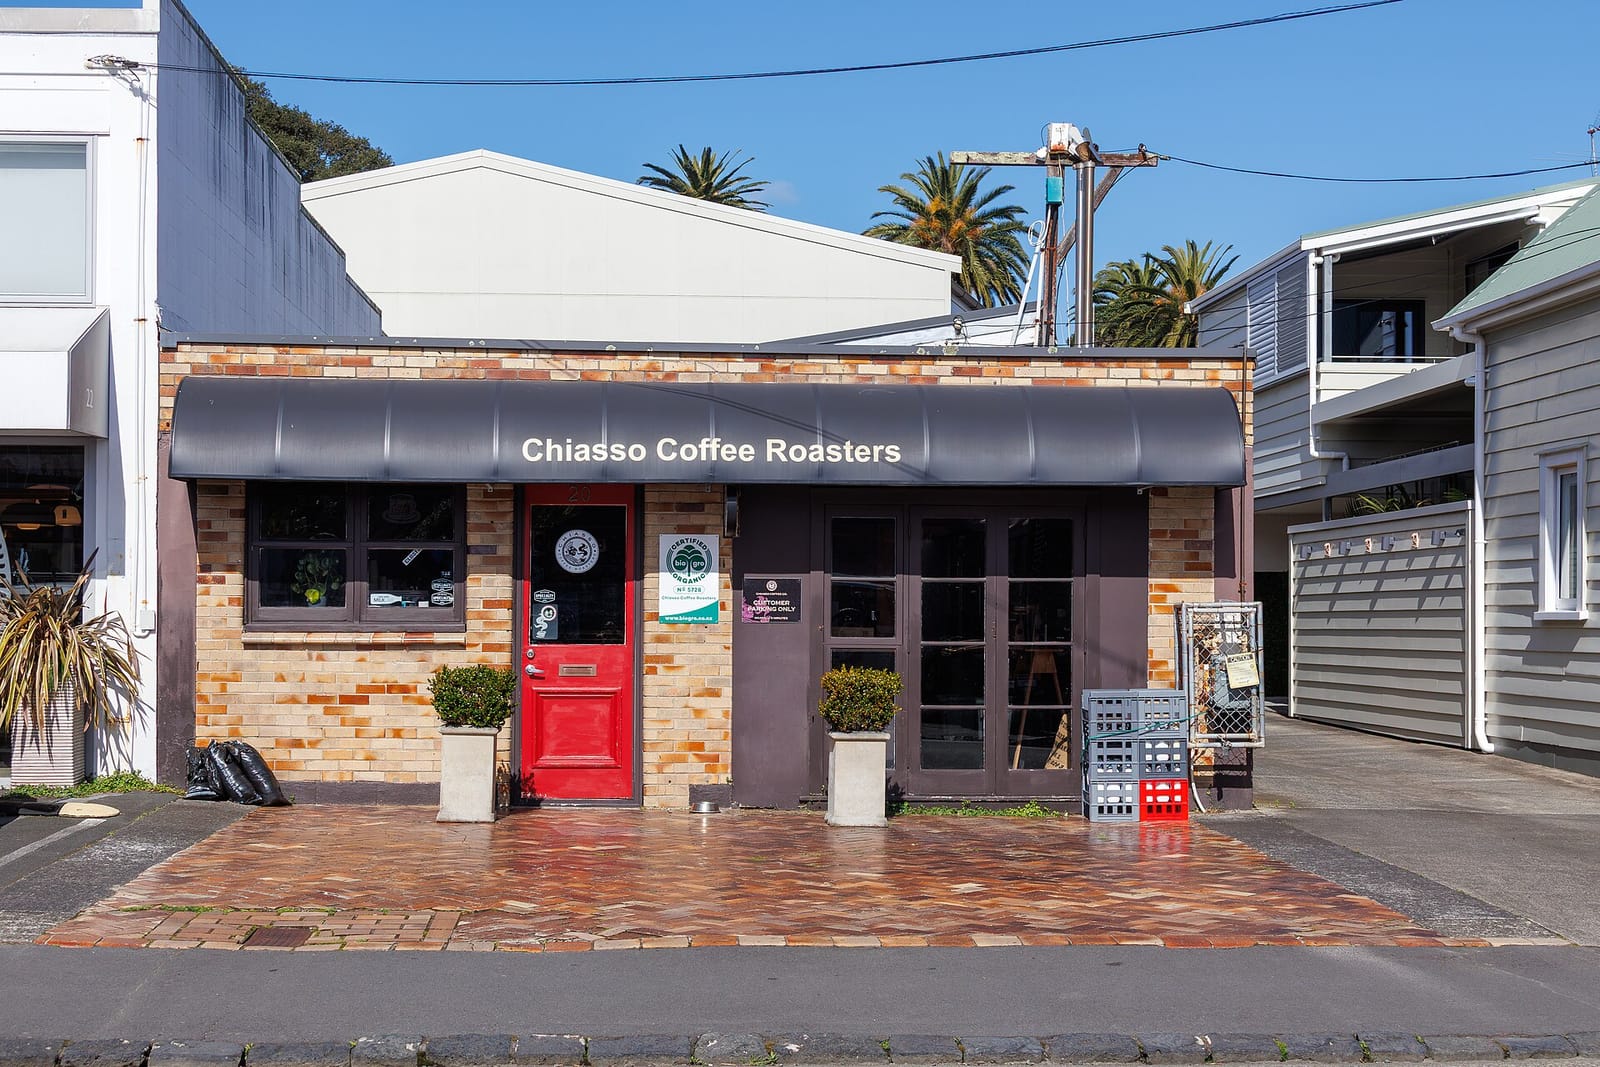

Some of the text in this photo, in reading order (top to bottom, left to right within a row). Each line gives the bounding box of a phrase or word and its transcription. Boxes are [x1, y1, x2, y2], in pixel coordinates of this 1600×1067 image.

[86, 388, 94, 409] 22
[521, 437, 902, 463] Chiasso Coffee Roasters
[568, 486, 591, 502] 20
[671, 538, 708, 550] CERTIFIED
[673, 573, 706, 584] ORGANIC
